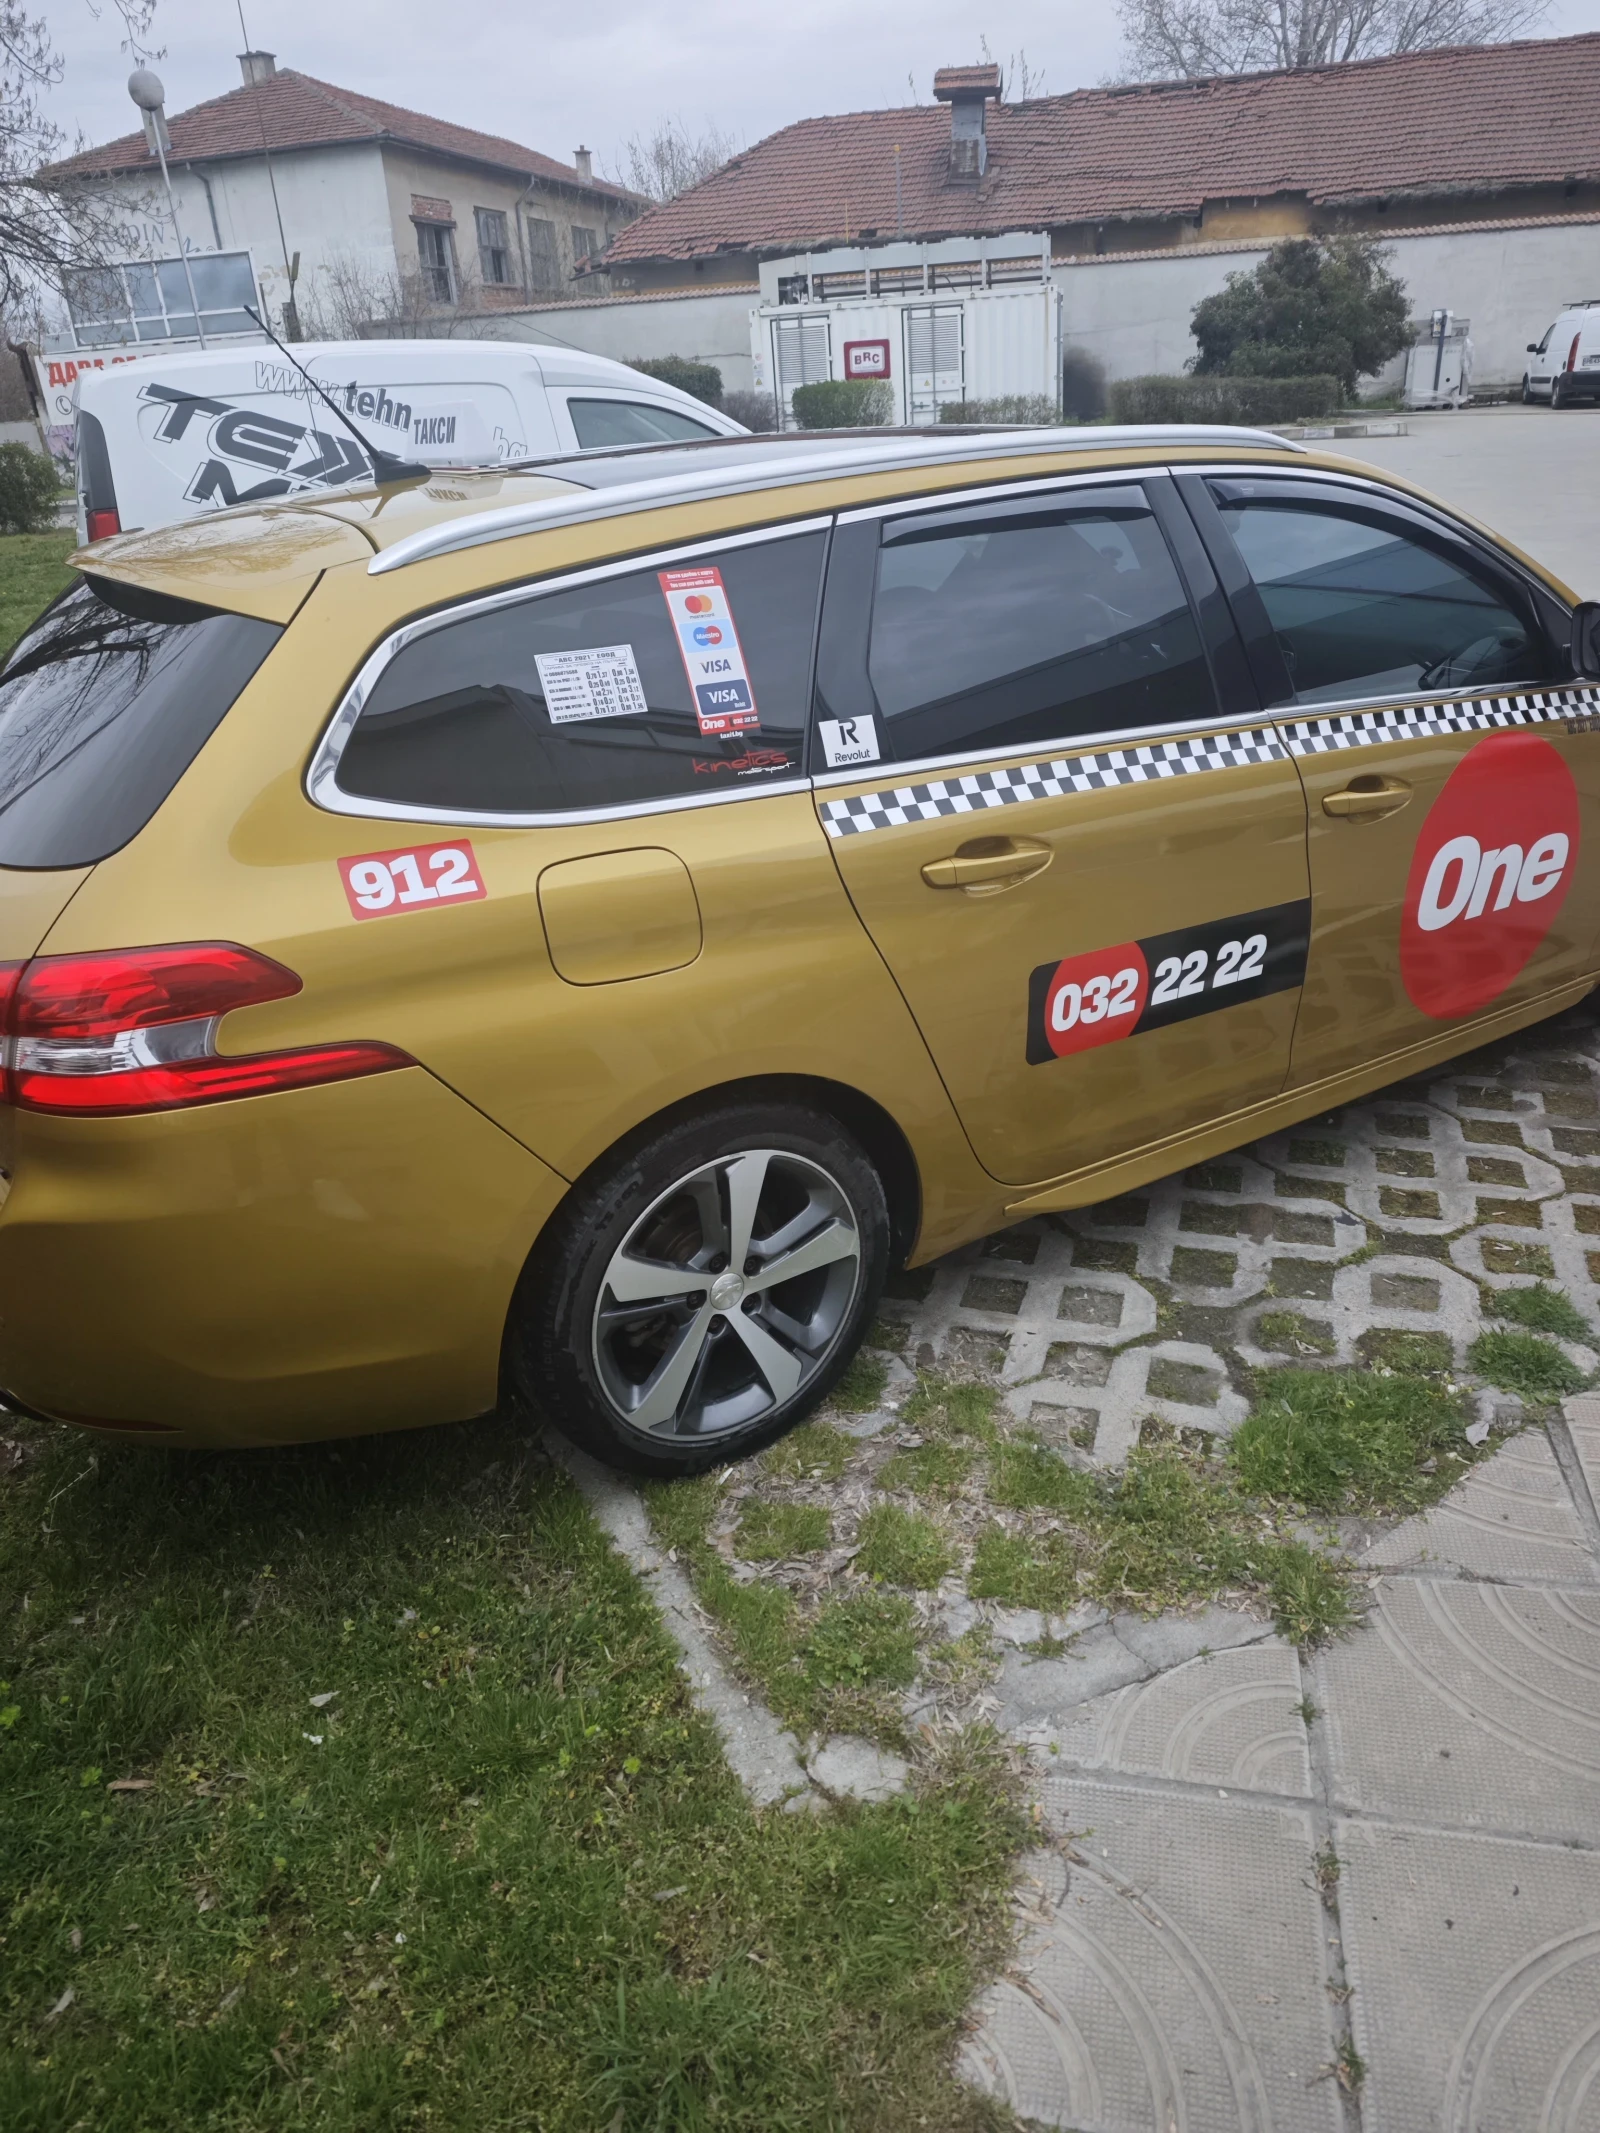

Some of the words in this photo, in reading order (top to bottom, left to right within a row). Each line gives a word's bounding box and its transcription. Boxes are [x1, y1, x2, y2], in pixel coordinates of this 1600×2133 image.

[854, 351, 880, 365] BRC
[413, 416, 456, 445] ТАКСИ
[696, 632, 720, 640] Maestro
[700, 659, 732, 674] VISA
[707, 689, 739, 704] VISA
[701, 719, 725, 730] One
[692, 749, 788, 774] kinetics
[834, 748, 871, 763] Revolut
[738, 761, 796, 775] motorsport
[349, 848, 479, 910] 912
[1417, 832, 1570, 931] One
[1051, 968, 1139, 1032] 032
[1150, 949, 1209, 1007] 22
[1212, 933, 1268, 989] 22
